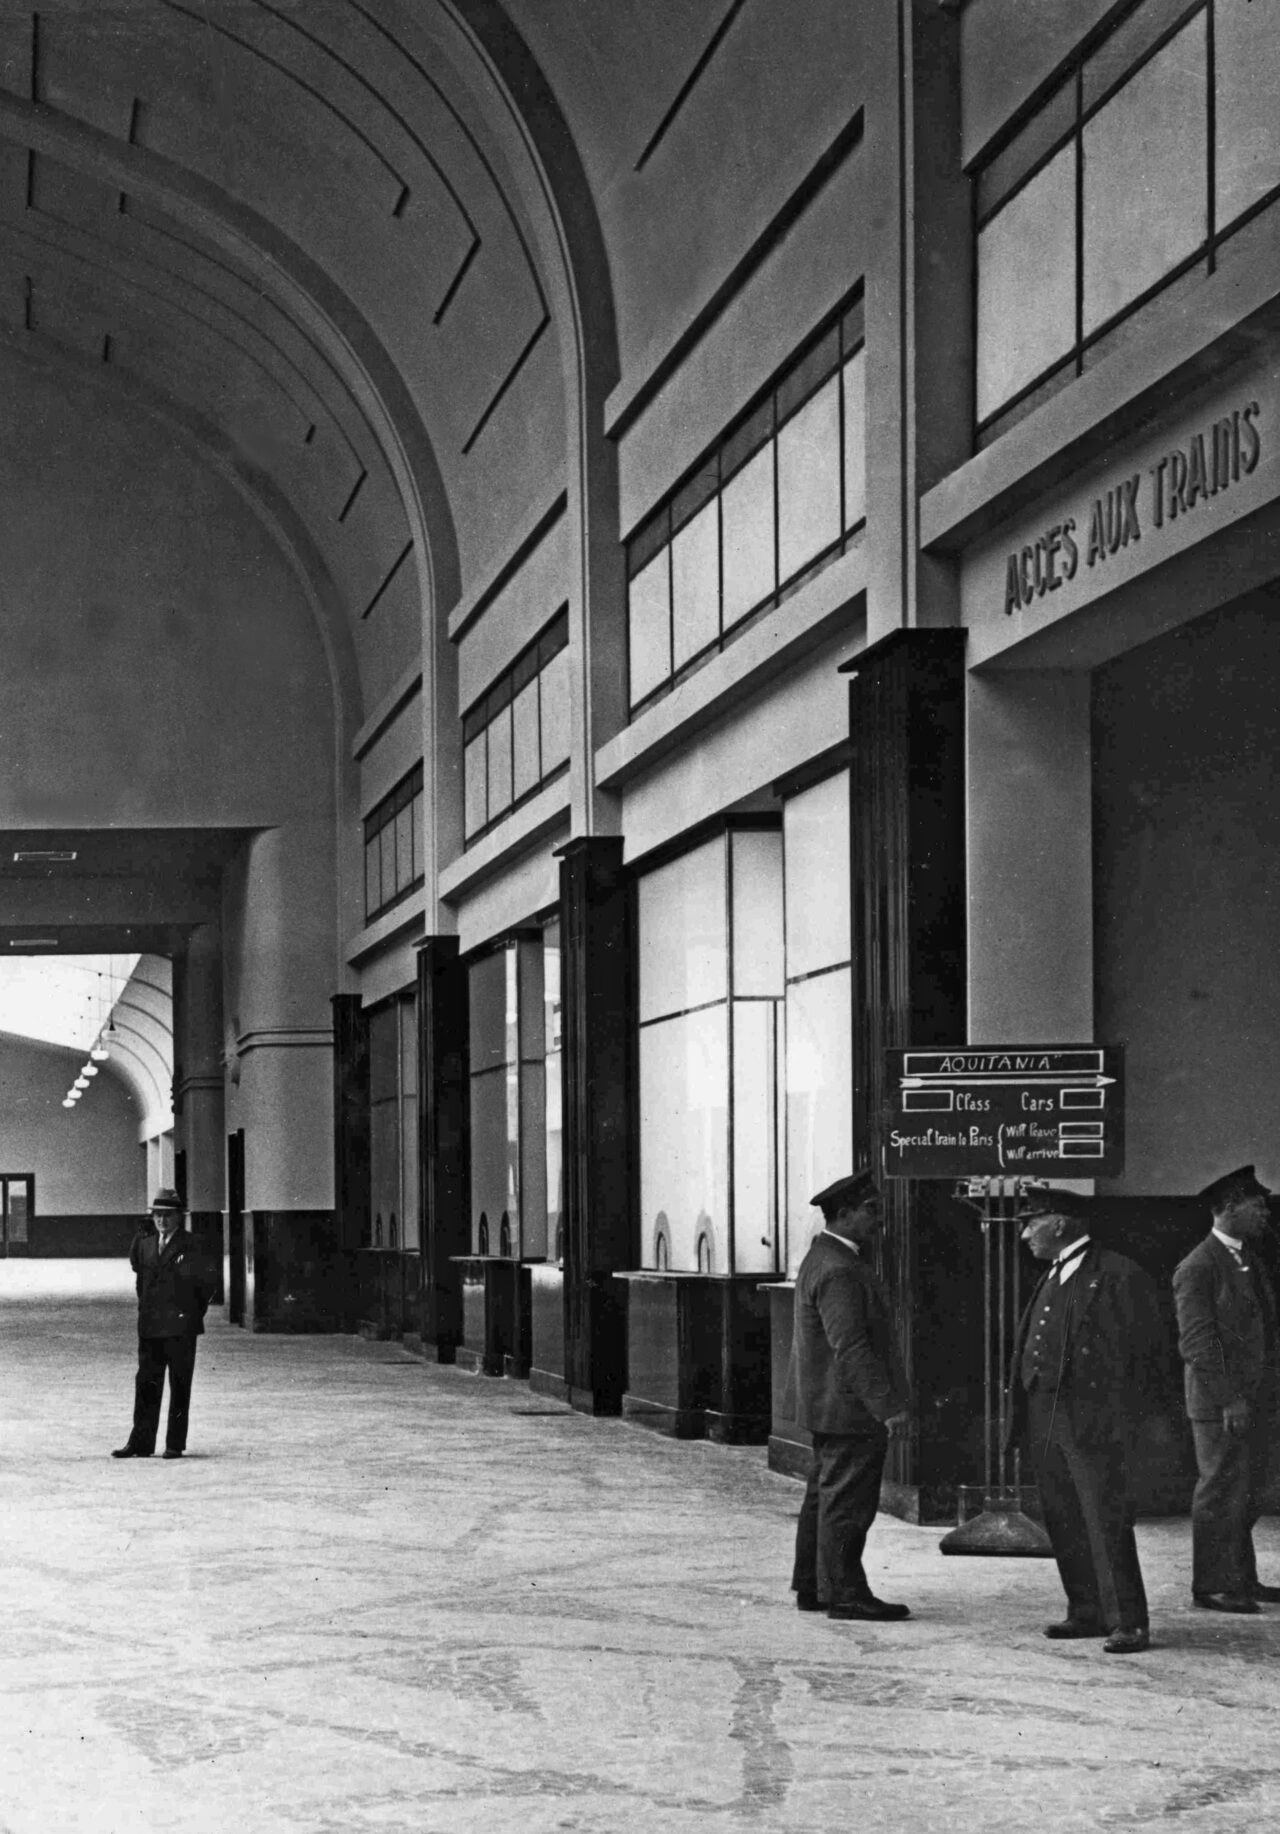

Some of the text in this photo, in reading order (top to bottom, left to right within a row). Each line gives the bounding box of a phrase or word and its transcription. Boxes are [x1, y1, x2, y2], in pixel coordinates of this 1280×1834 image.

[1004, 400, 1261, 615] ACCES AUX TRAINS
[955, 1092, 1054, 1112] Class Cars
[1006, 1122, 1058, 1138] Will leave
[890, 1126, 994, 1158] Special train to Paris
[1006, 1147, 1060, 1160] Will arrive
